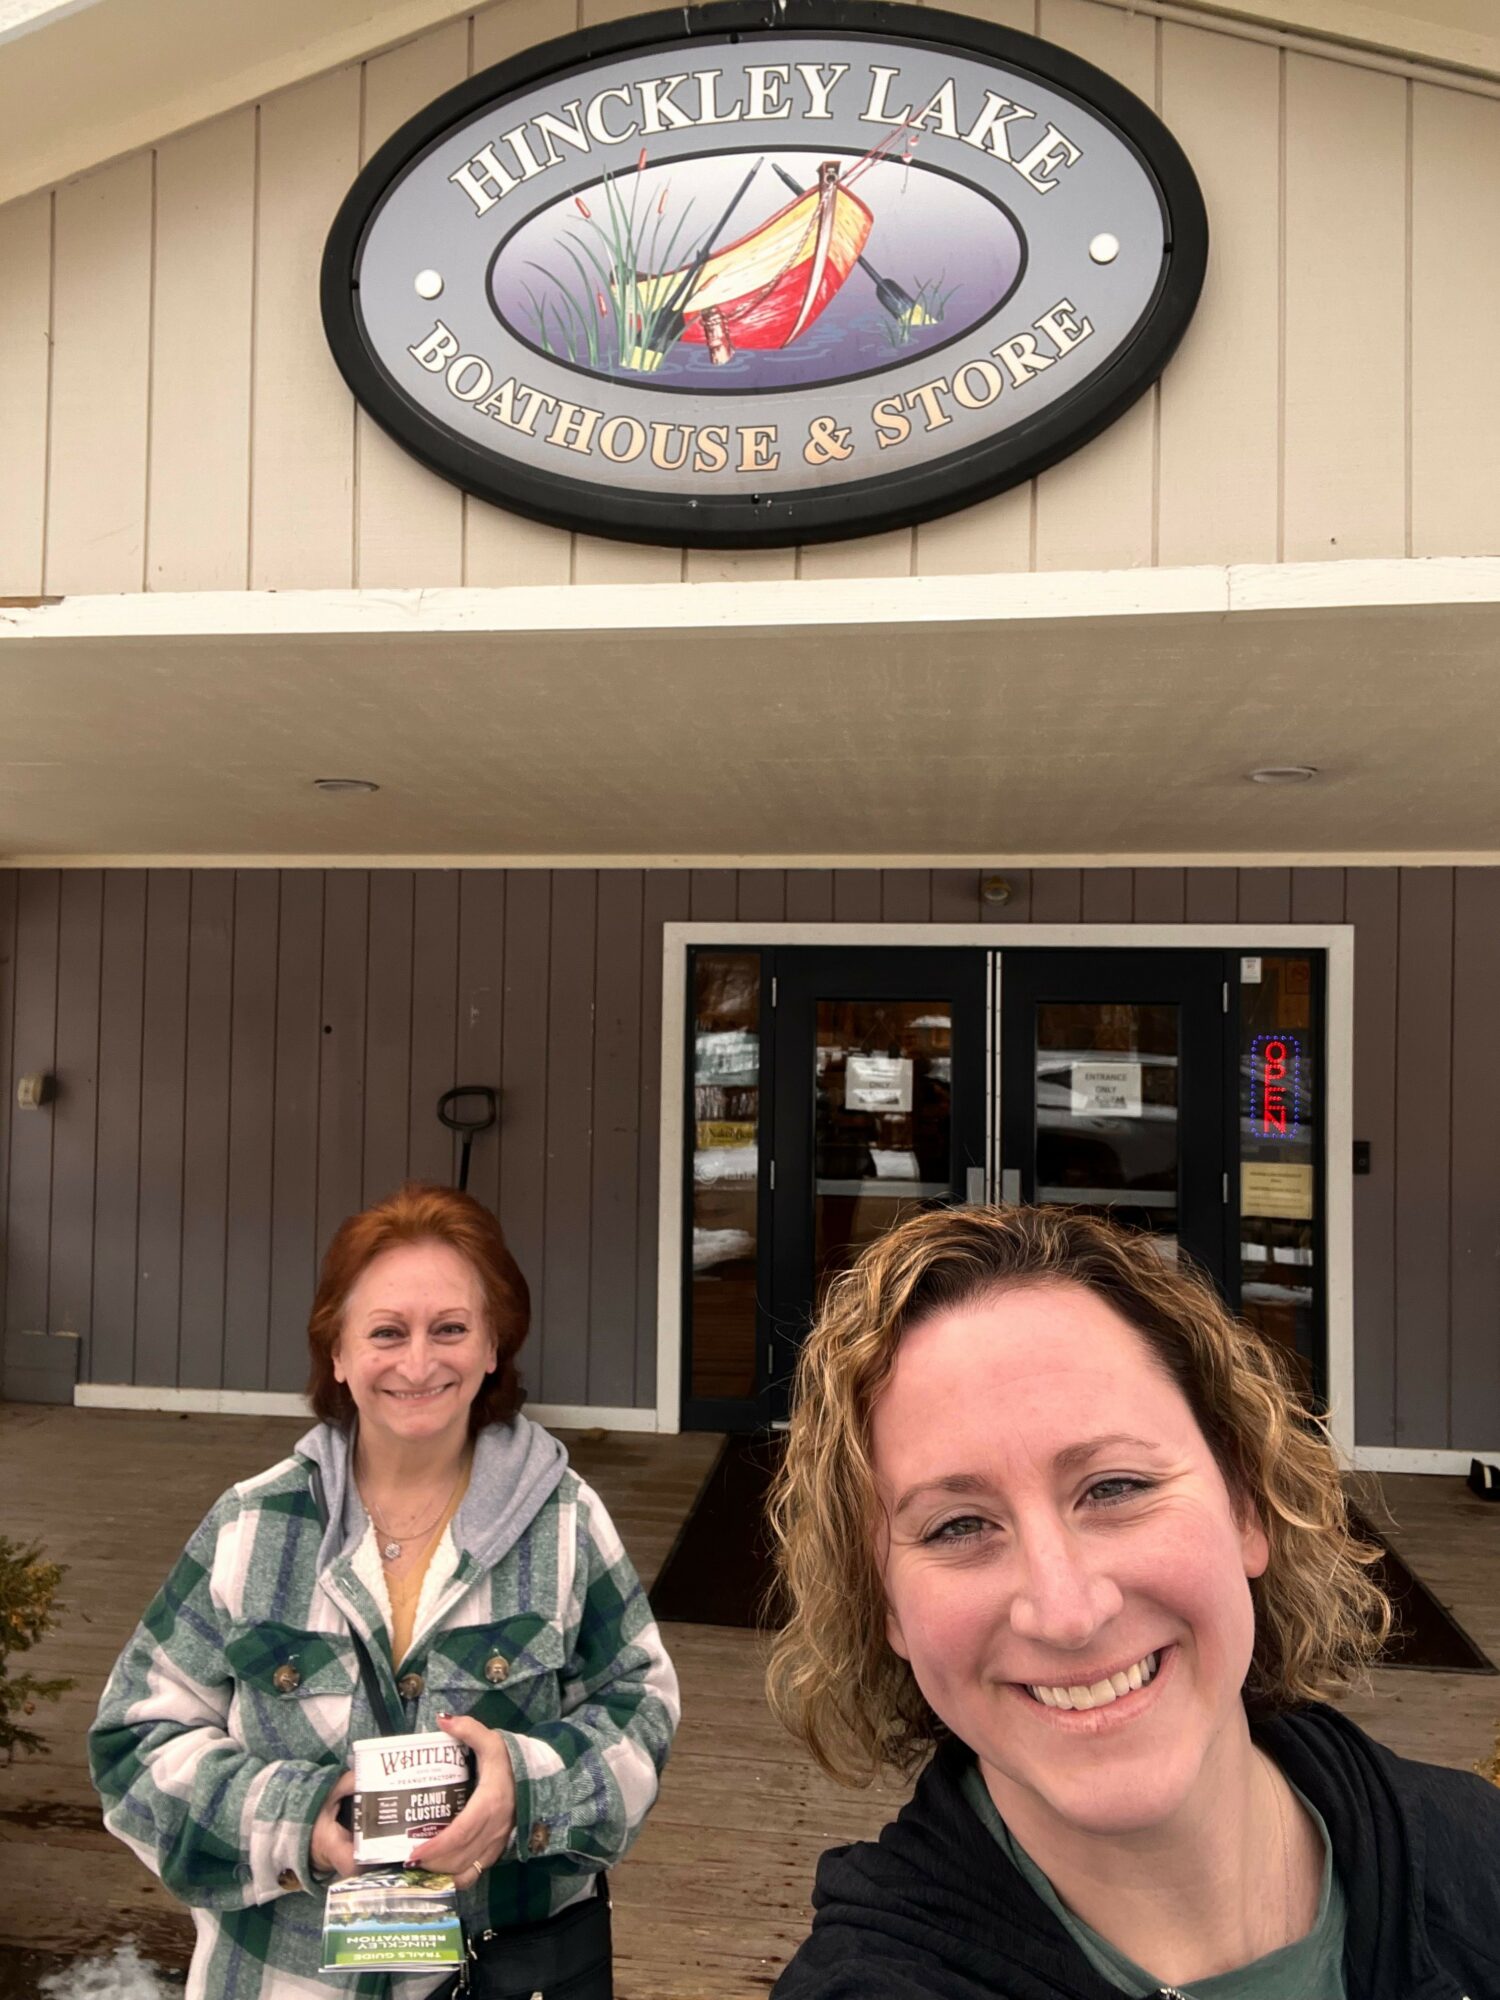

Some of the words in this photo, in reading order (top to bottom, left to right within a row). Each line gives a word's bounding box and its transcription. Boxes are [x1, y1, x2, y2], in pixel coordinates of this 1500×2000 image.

[448, 63, 851, 218] HINCKLEY
[859, 65, 1084, 195] LAKE
[406, 319, 781, 473] BOATHOUSE
[802, 415, 855, 466] &
[871, 297, 1096, 449] STORE
[1085, 1072, 1128, 1081] ENTRANCE
[868, 1081, 891, 1089] ONLY
[1095, 1086, 1117, 1094] ONLY
[1264, 1041, 1288, 1134] OPEN
[410, 1791, 447, 1807] PEANUT
[404, 1804, 452, 1822] CLUSTERS
[346, 1934, 446, 1944] RESERVATION
[357, 1941, 437, 1950] HINCKLEY
[353, 1952, 395, 1960] GUIDE
